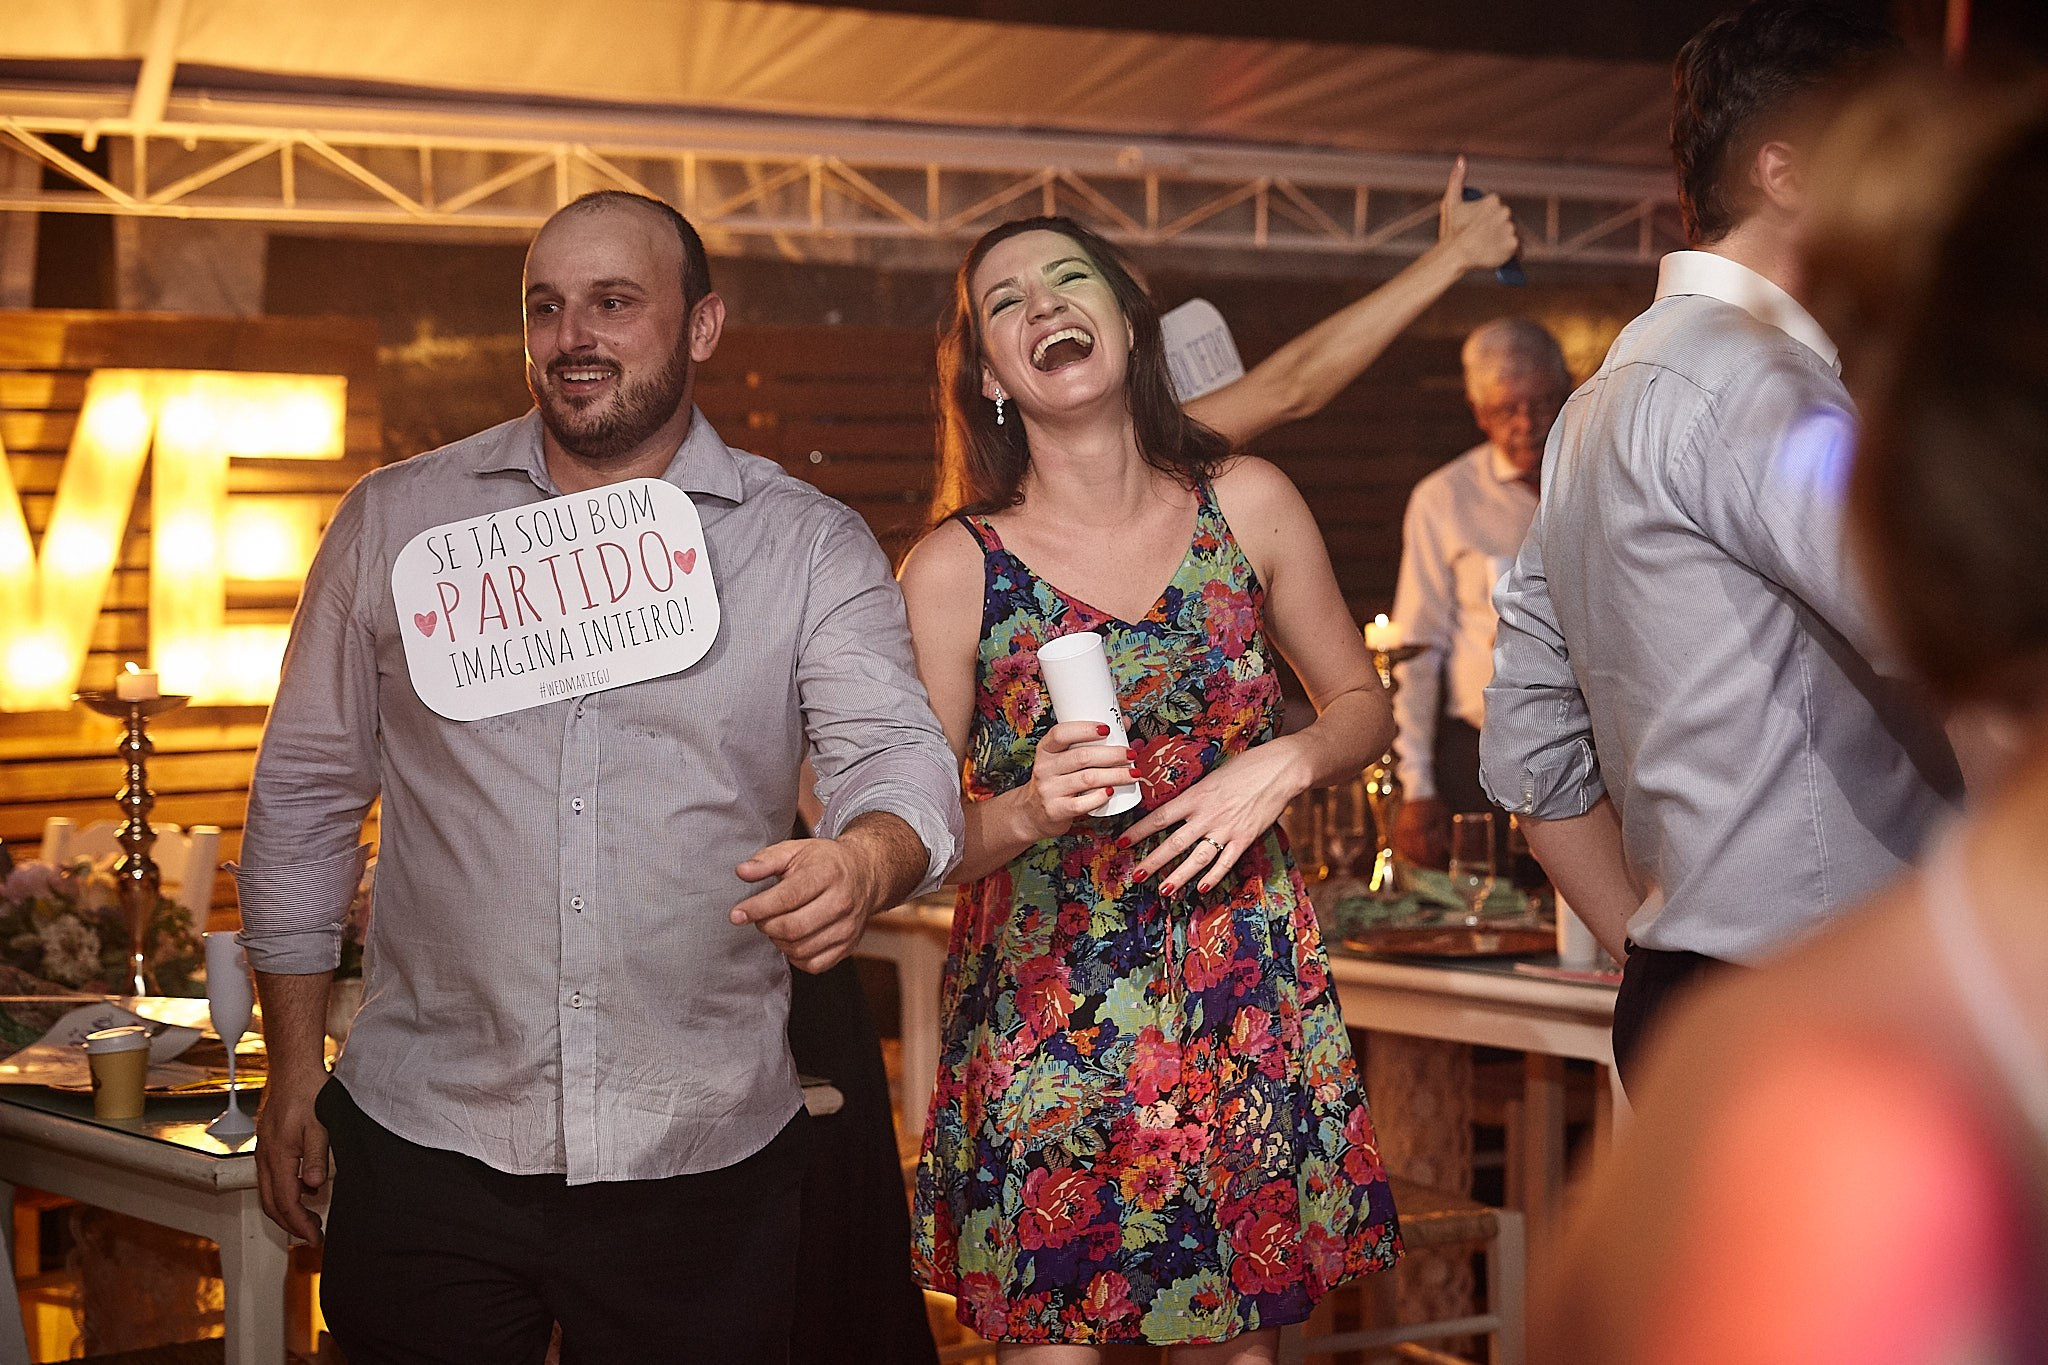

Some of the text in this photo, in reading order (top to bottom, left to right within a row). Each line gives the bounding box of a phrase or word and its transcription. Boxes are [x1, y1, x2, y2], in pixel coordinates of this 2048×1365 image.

[426, 484, 656, 575] SE JÁ SOU BOM
[436, 530, 674, 643] PARTIDO
[449, 596, 695, 688] IMAGINA INTEIRO!
[539, 667, 611, 699] #WEDMARIEGU
